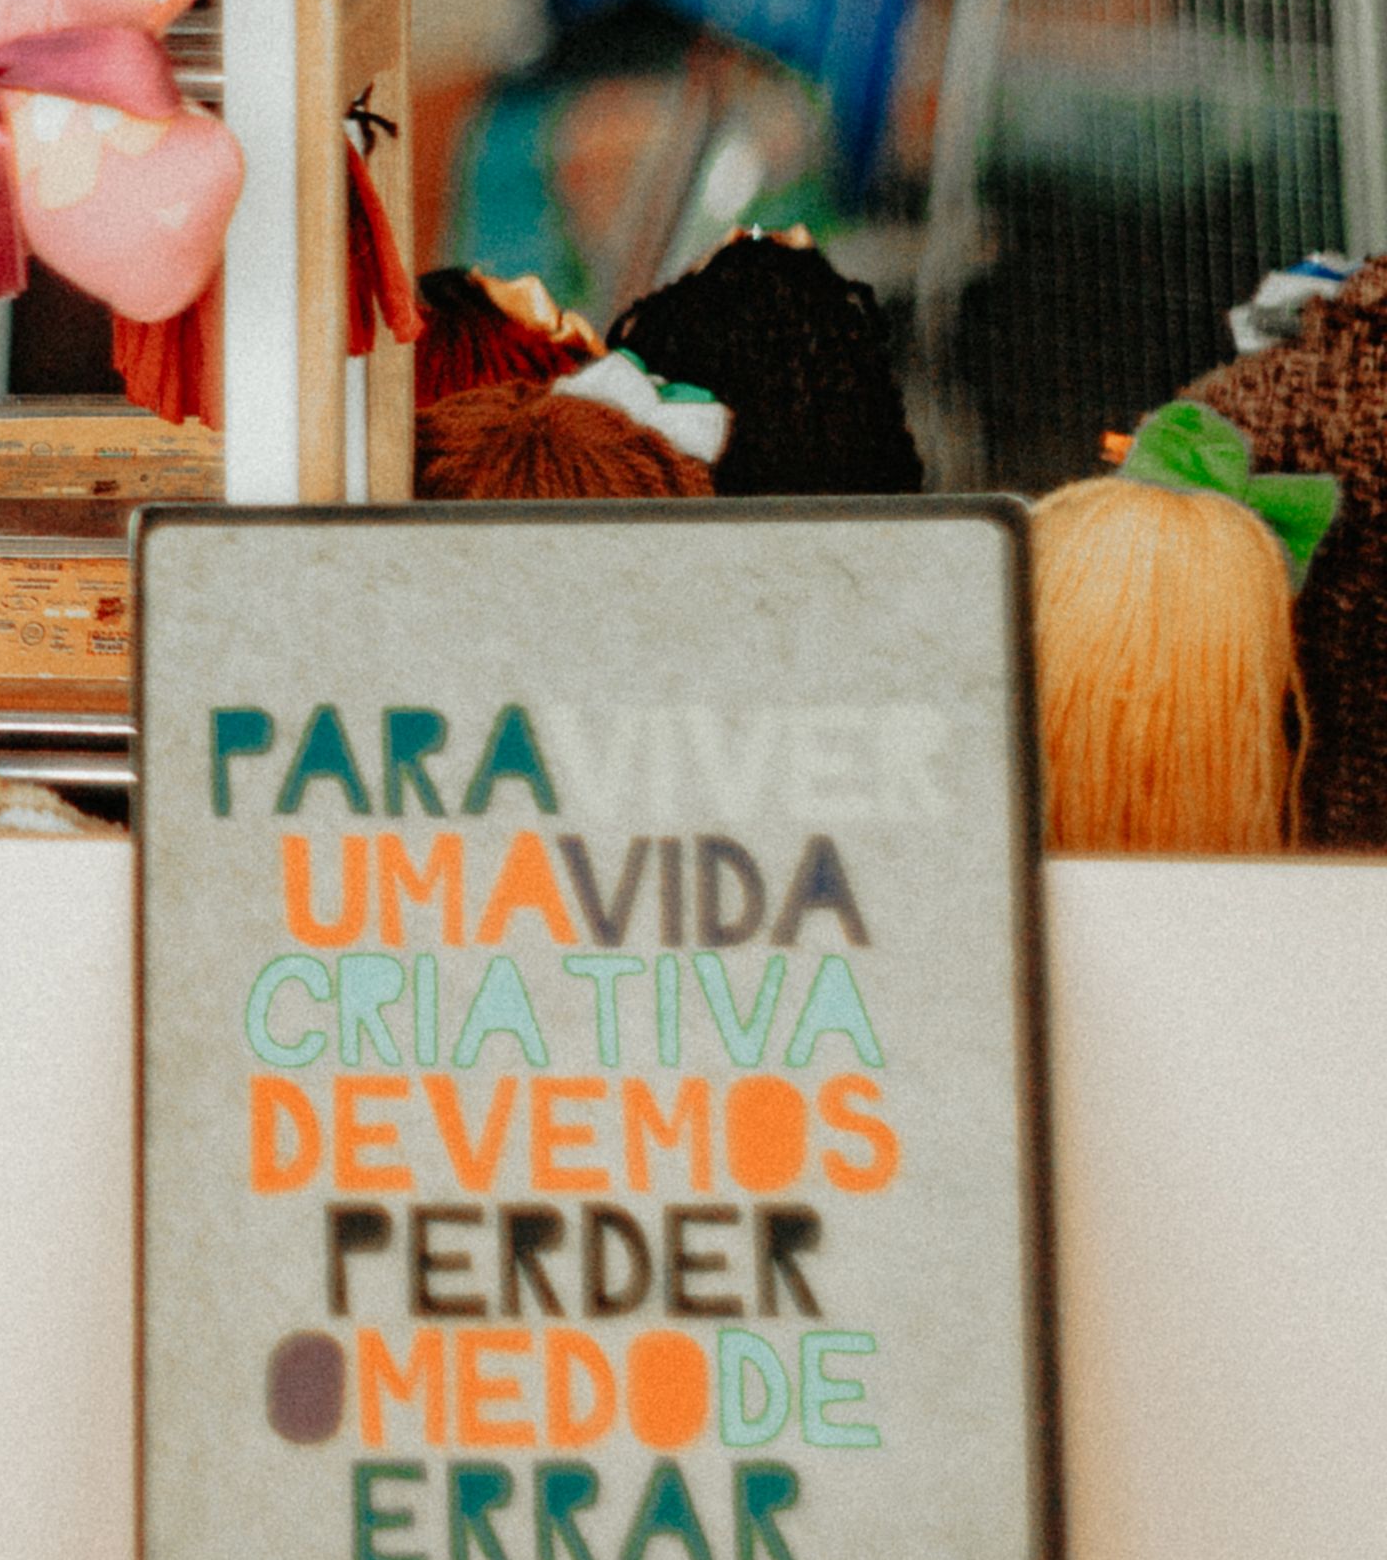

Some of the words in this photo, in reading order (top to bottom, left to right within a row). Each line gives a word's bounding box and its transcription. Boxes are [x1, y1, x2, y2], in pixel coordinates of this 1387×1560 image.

[209, 703, 558, 818] PARA
[555, 702, 951, 822] VIVER
[280, 831, 579, 949] UMA
[556, 833, 873, 947] VIDA
[245, 952, 885, 1068] CRIATIVA
[249, 1073, 900, 1194] DEVEMOS
[326, 1202, 824, 1319] PERDER
[265, 1328, 346, 1446] O
[356, 1327, 711, 1451] MEDO
[717, 1328, 881, 1447] DE
